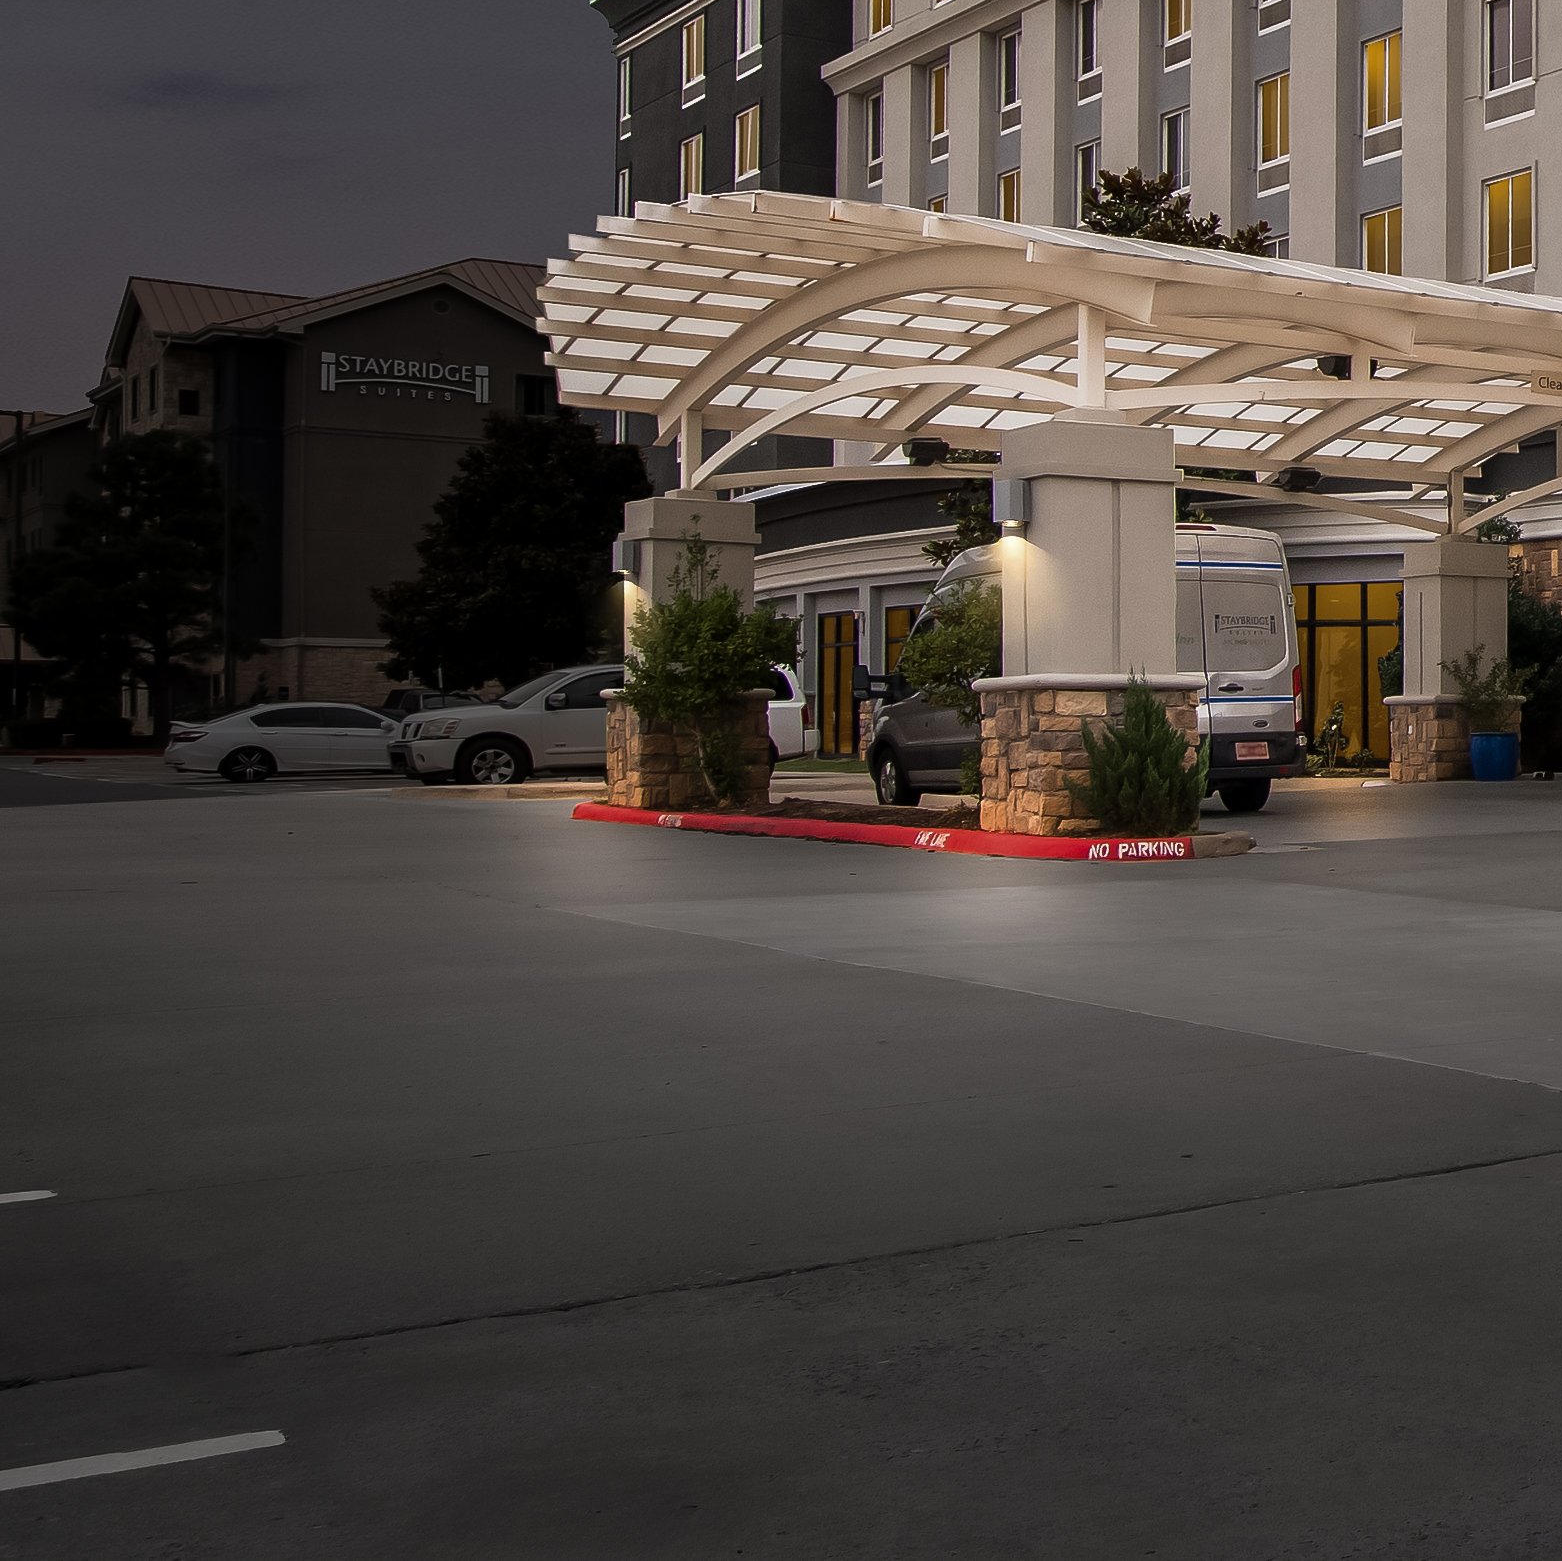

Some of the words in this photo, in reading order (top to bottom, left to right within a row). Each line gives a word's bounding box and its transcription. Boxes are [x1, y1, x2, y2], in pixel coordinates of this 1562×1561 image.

[338, 355, 472, 382] STAYBRIDGE
[359, 385, 452, 401] SUITES
[1220, 615, 1270, 626] STAYBRIDGE
[1088, 843, 1110, 860] NO
[1118, 842, 1185, 859] PARKING
